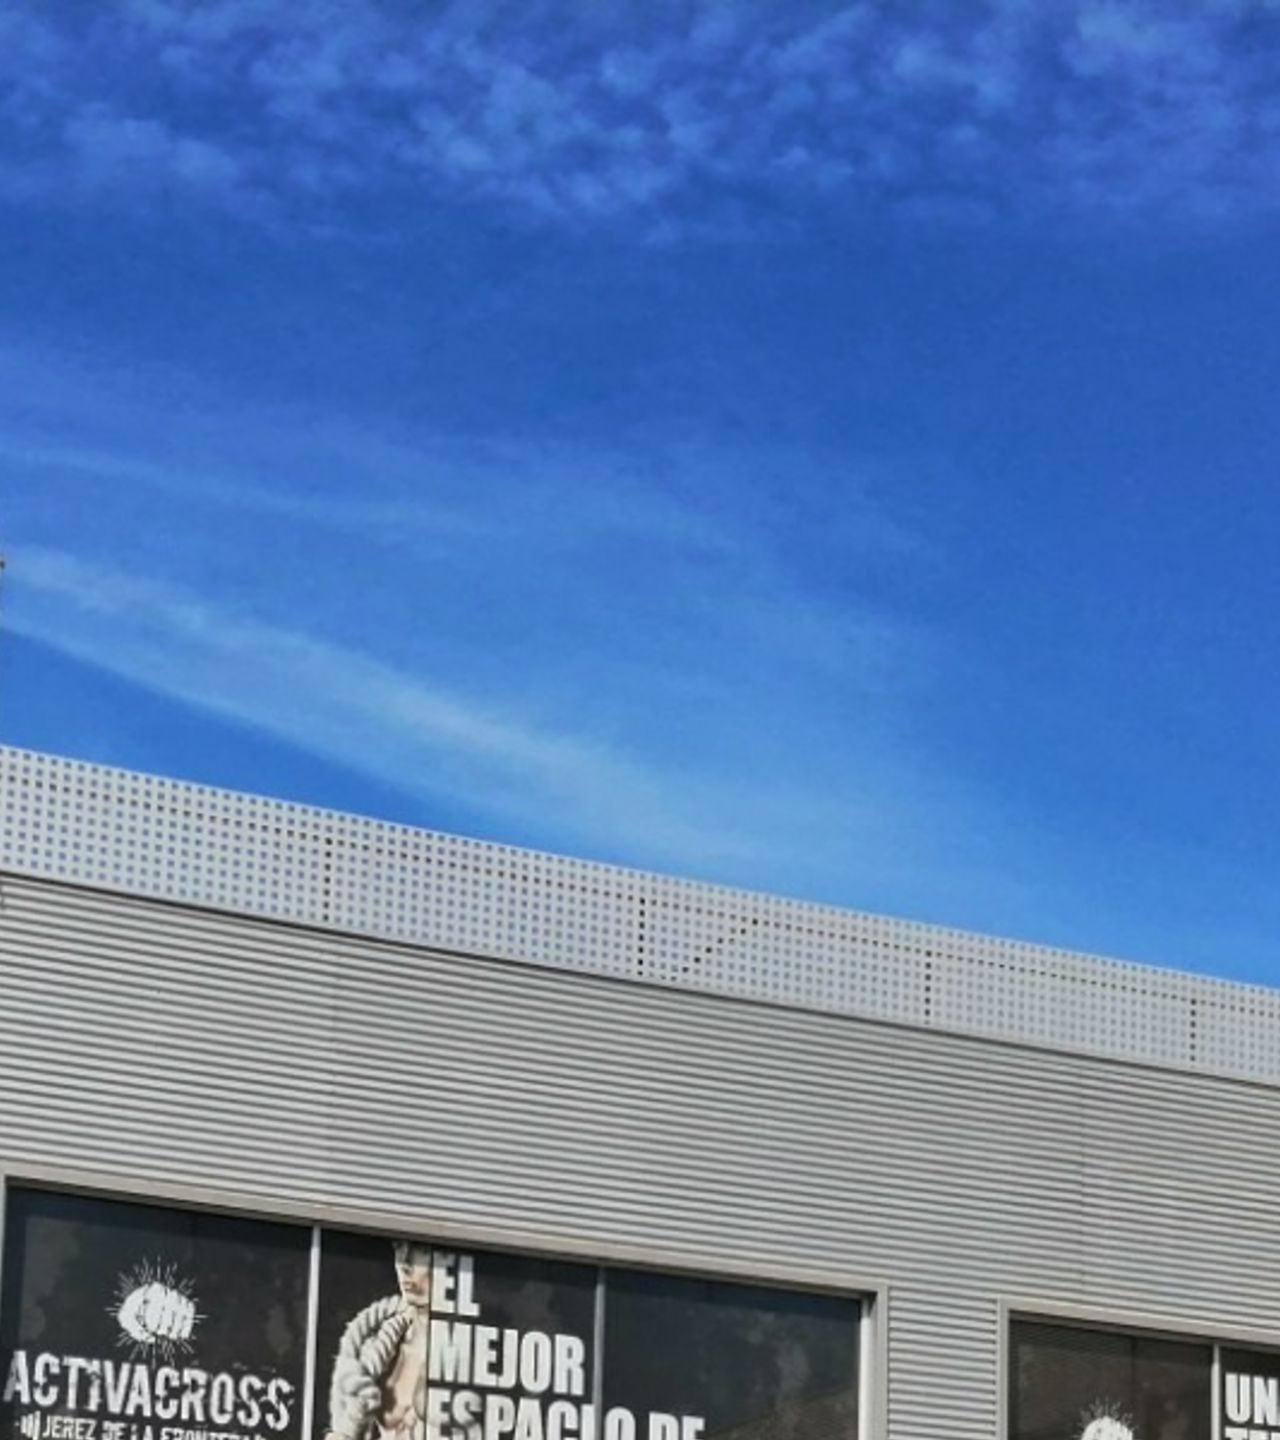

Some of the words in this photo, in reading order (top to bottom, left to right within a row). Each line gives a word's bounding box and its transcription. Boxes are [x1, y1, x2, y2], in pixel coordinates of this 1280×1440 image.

[431, 1253, 480, 1316] EL
[3, 1350, 295, 1431] ACTIVACROSS
[428, 1319, 585, 1396] MEJOR
